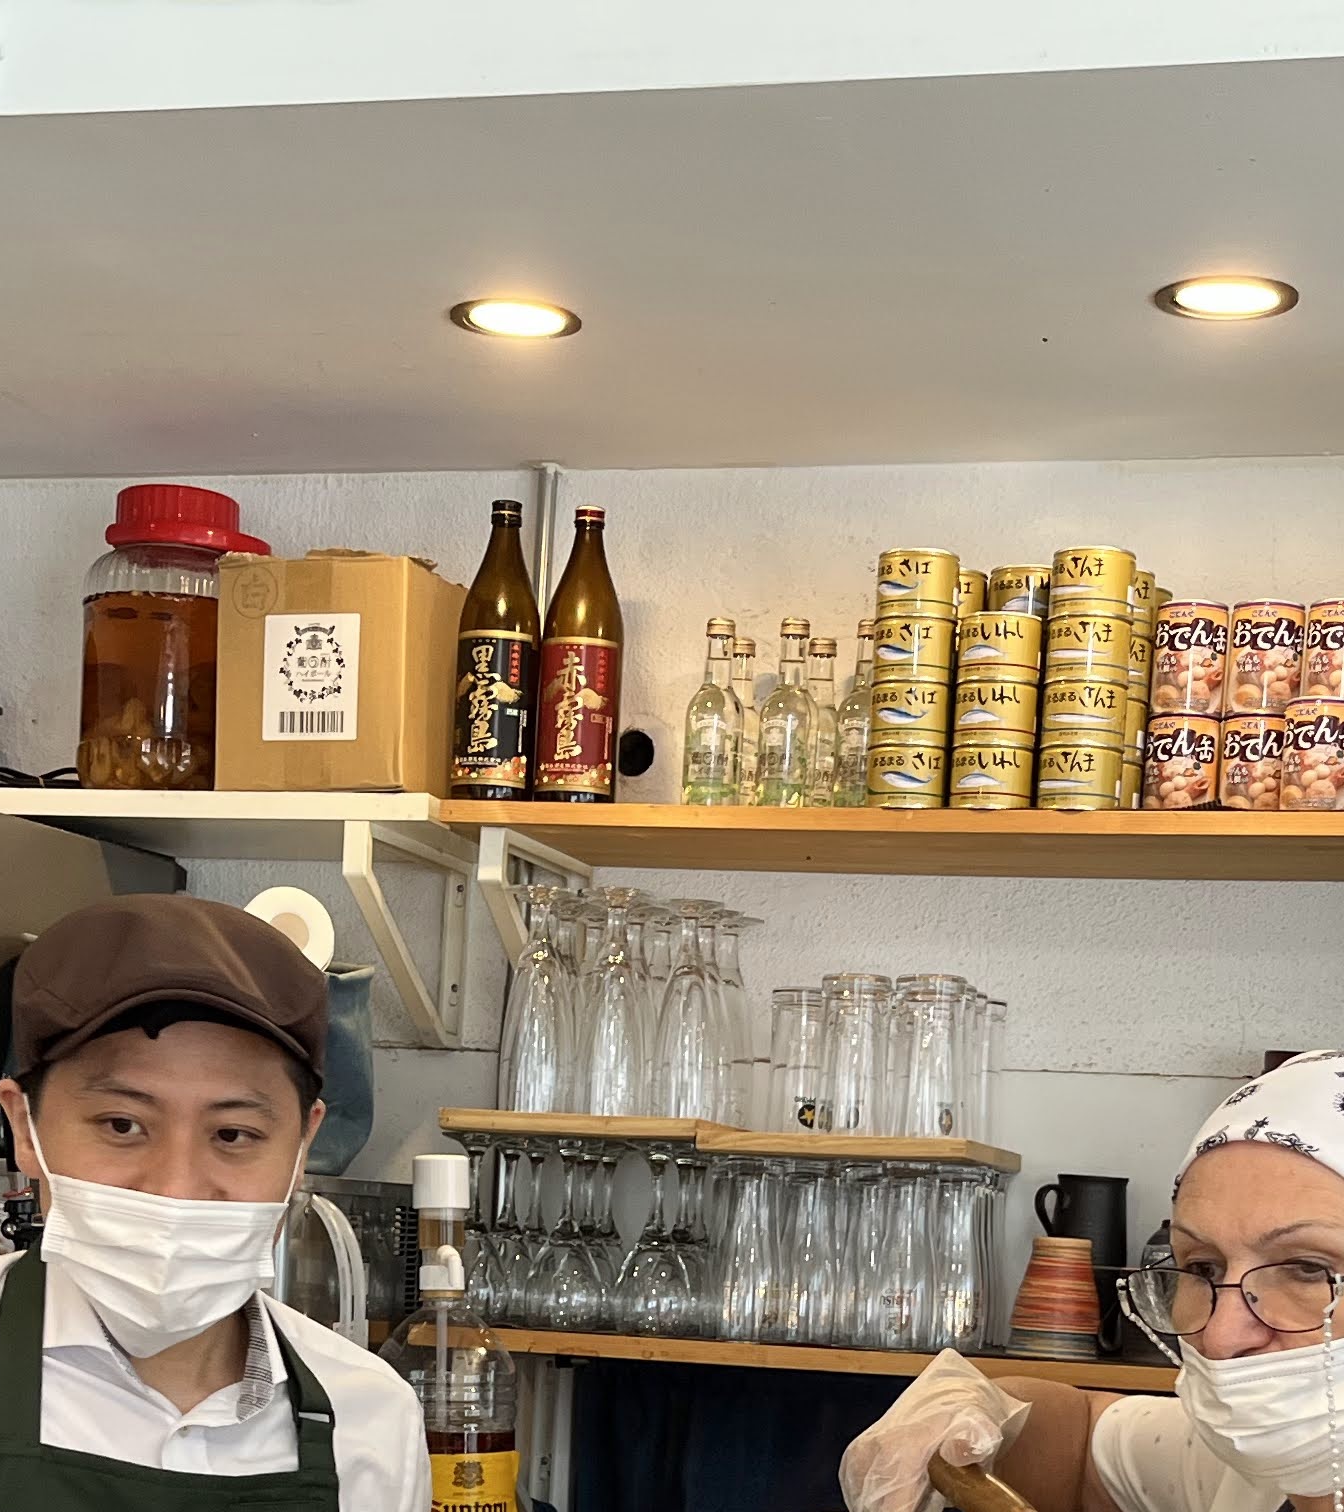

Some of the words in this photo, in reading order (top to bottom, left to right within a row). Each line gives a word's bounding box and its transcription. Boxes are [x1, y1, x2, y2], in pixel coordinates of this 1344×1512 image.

[898, 558, 933, 577] さば
[1066, 555, 1106, 579] さんま
[980, 620, 1024, 640] いわし
[1155, 619, 1228, 653] おでん缶
[467, 643, 501, 755] 黒霧島
[554, 650, 588, 761] 赤霧島
[904, 687, 938, 706] さば
[977, 685, 1021, 706] いわし
[1078, 686, 1117, 709] さんま
[911, 751, 942, 770] さば
[977, 750, 1021, 770] いわし
[1056, 749, 1097, 774] さんま
